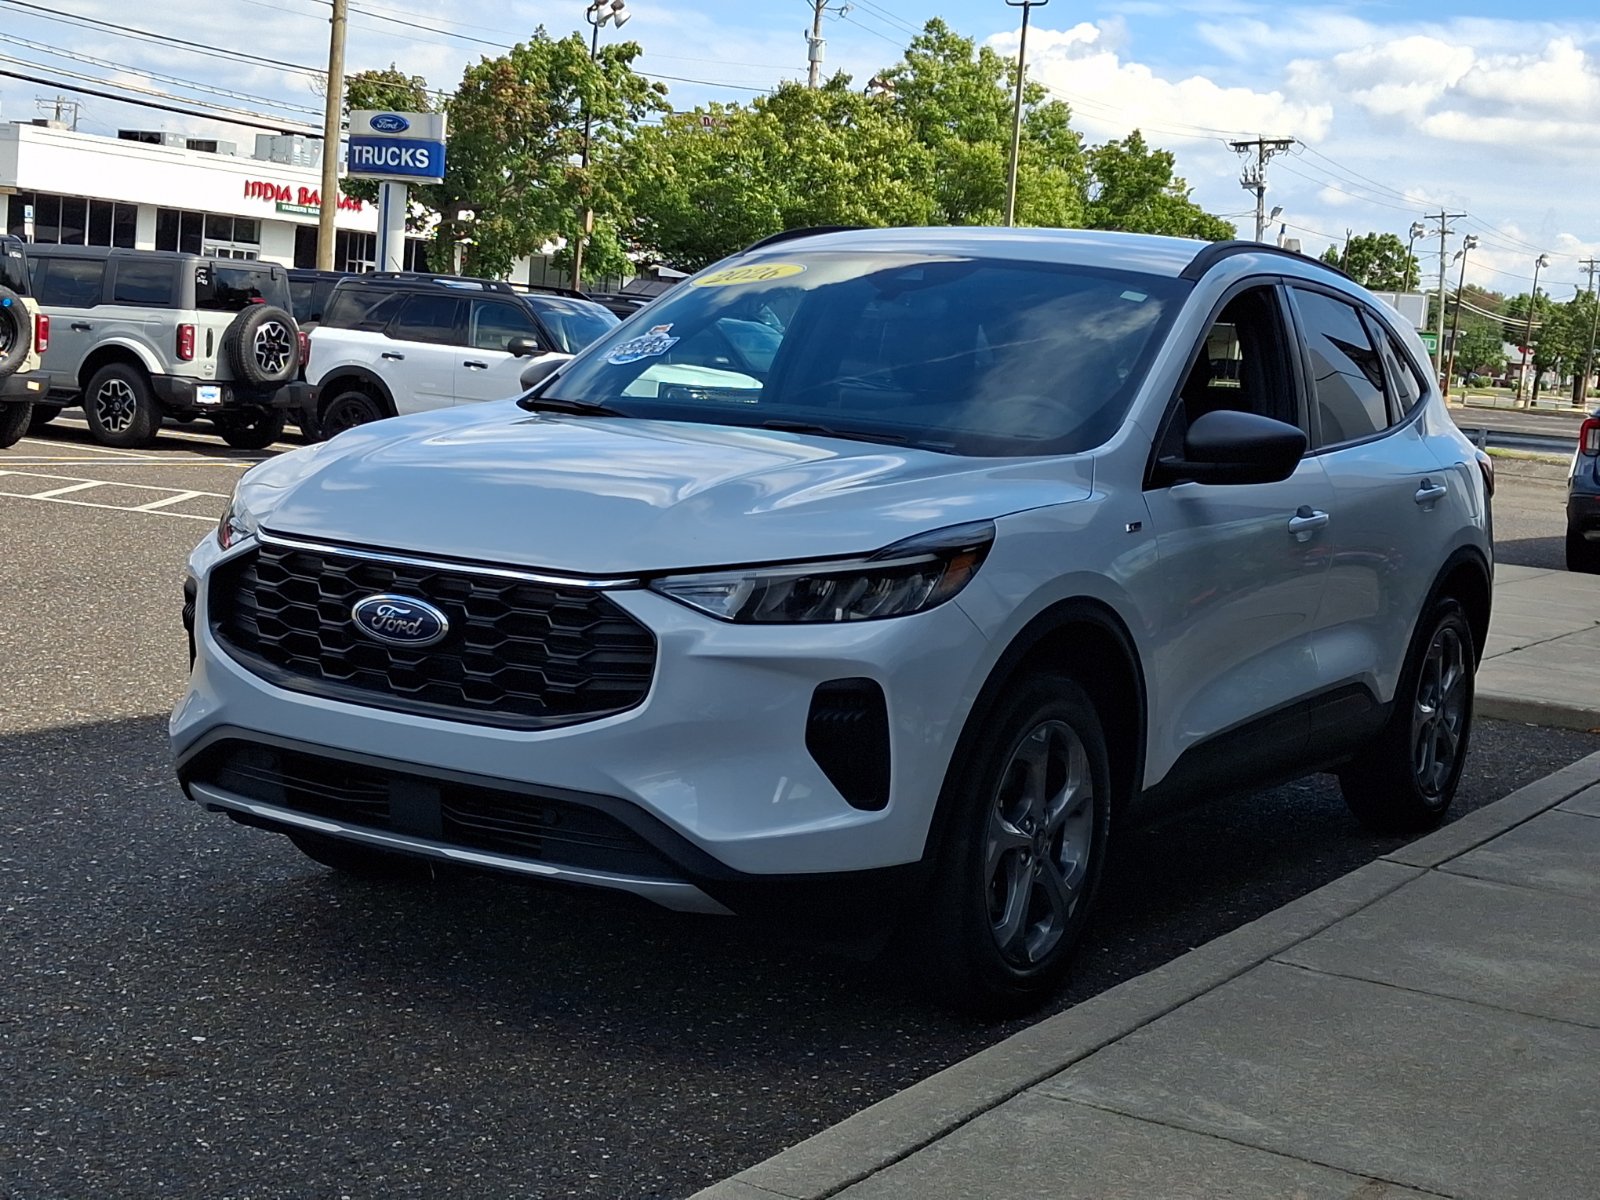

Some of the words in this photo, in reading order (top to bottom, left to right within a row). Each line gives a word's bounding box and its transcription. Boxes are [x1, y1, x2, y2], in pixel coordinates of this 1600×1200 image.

[376, 118, 398, 130] Ford
[352, 145, 430, 168] TRUCKS
[243, 179, 292, 203] INDIA
[298, 186, 363, 213] BAAR
[371, 604, 424, 636] Ford
